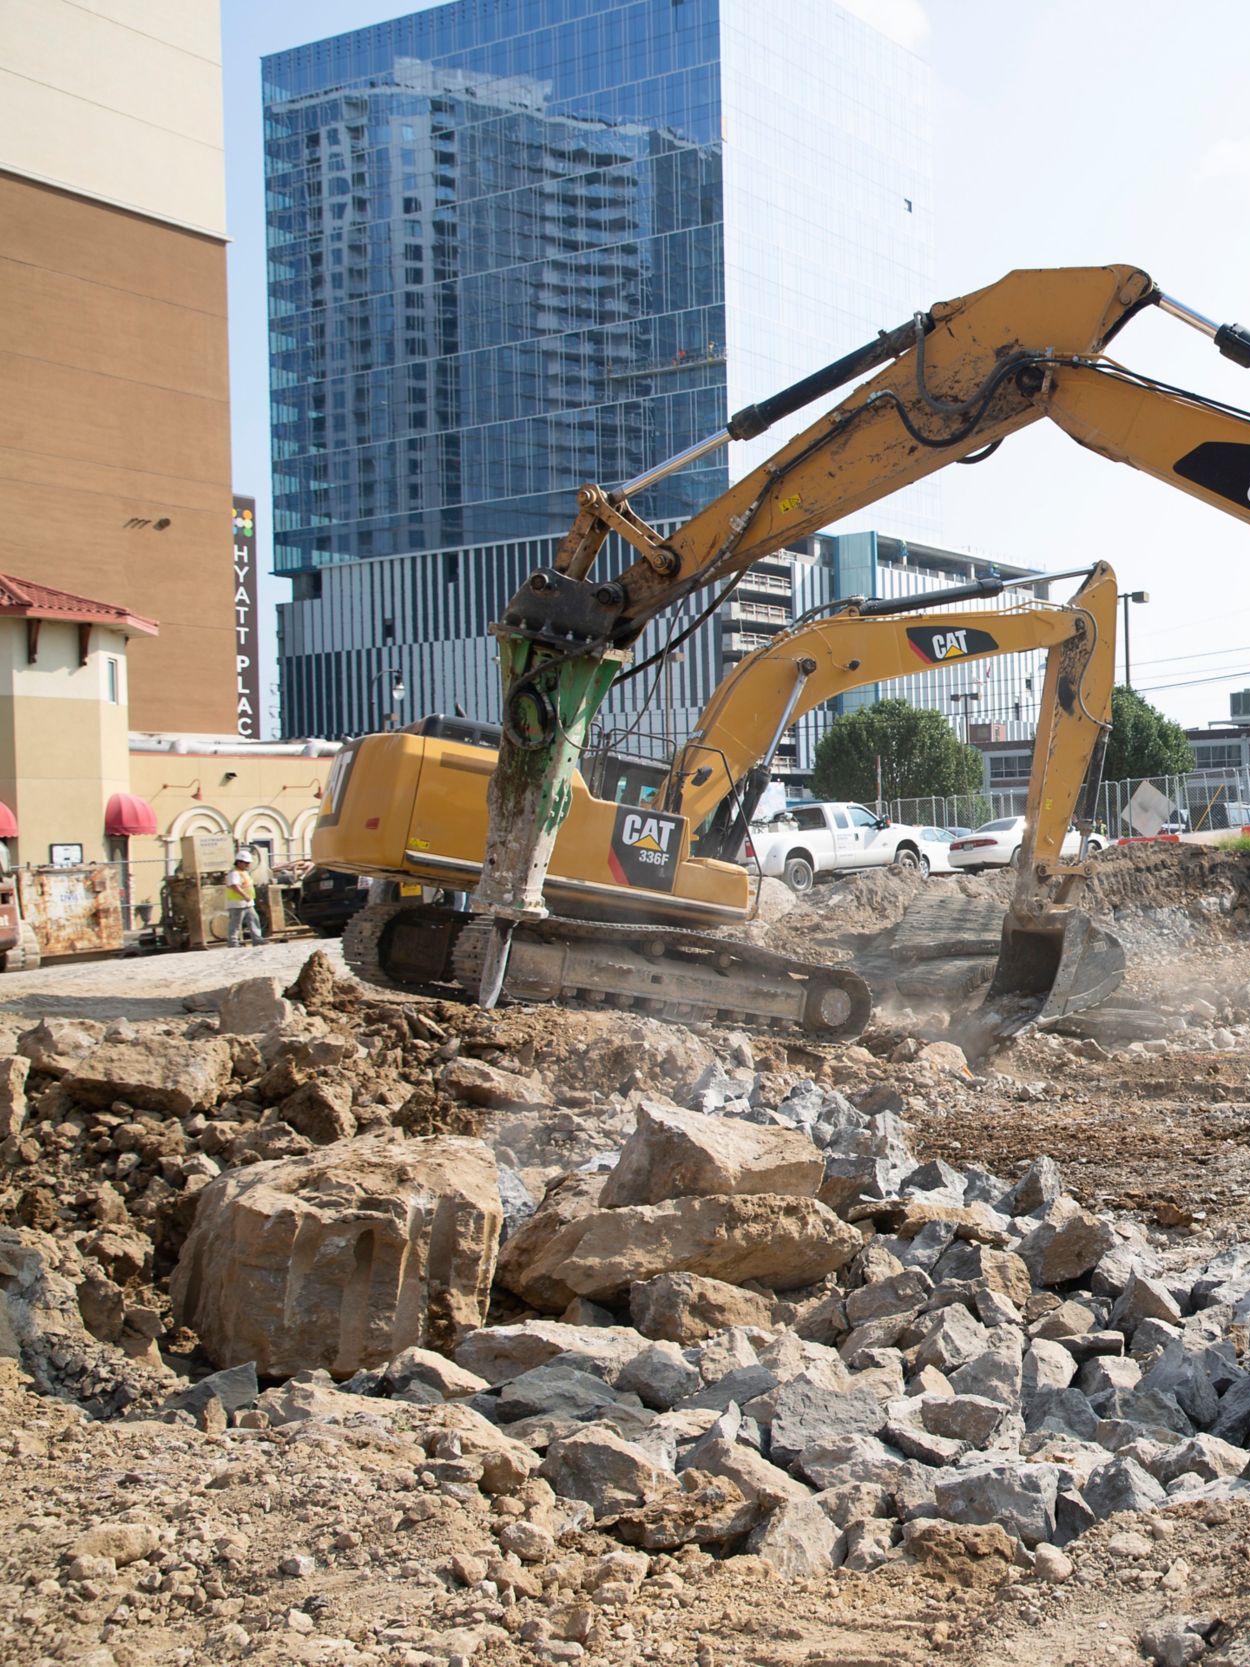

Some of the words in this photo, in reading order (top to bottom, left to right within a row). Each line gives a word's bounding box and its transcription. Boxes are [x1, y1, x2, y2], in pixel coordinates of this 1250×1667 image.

[233, 545, 250, 644] HYATT
[932, 630, 967, 659] CAT
[622, 814, 676, 851] CAT
[639, 850, 669, 865] 336F
